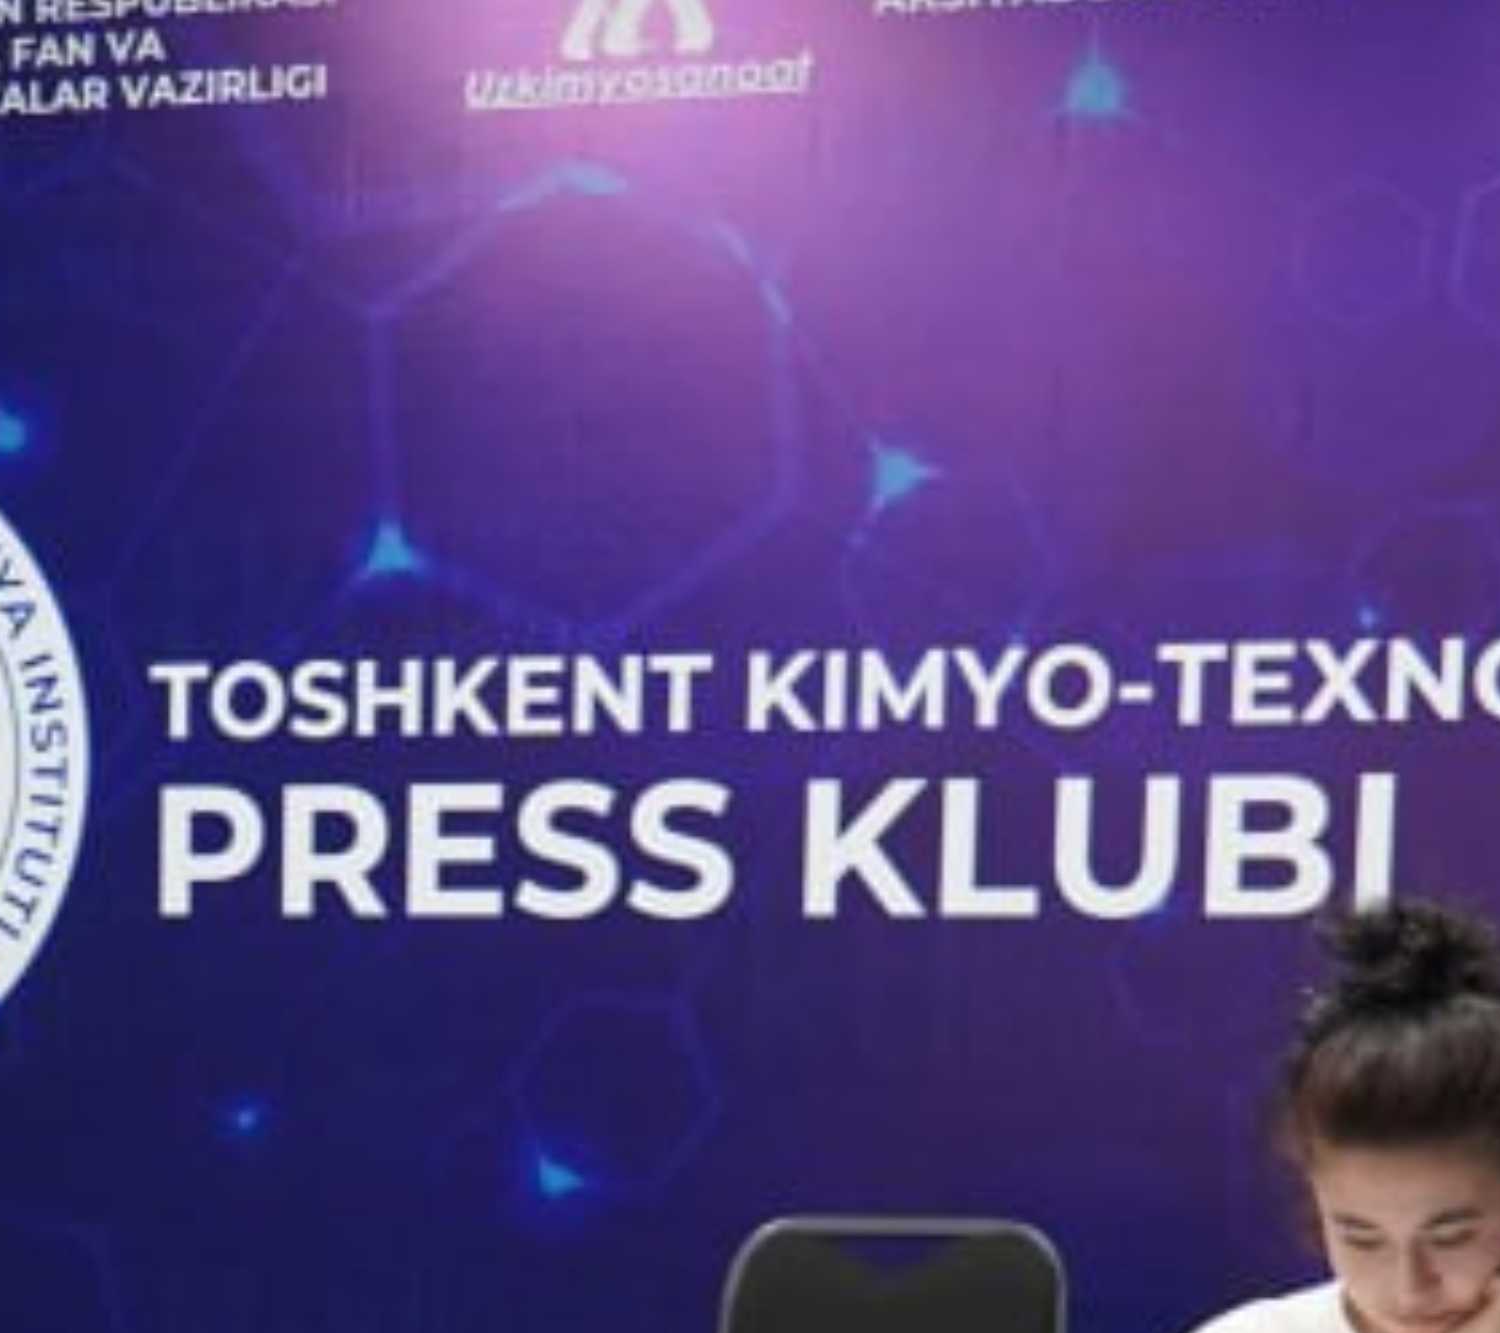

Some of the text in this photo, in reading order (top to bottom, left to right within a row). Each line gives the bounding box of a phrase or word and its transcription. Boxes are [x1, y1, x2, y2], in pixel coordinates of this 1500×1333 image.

[12, 33, 95, 70] FAN
[106, 29, 166, 62] VA
[120, 65, 327, 108] VAZIRLIGI
[149, 653, 712, 740] TOSHKENT
[157, 772, 1397, 920] PRESS KLUBI
